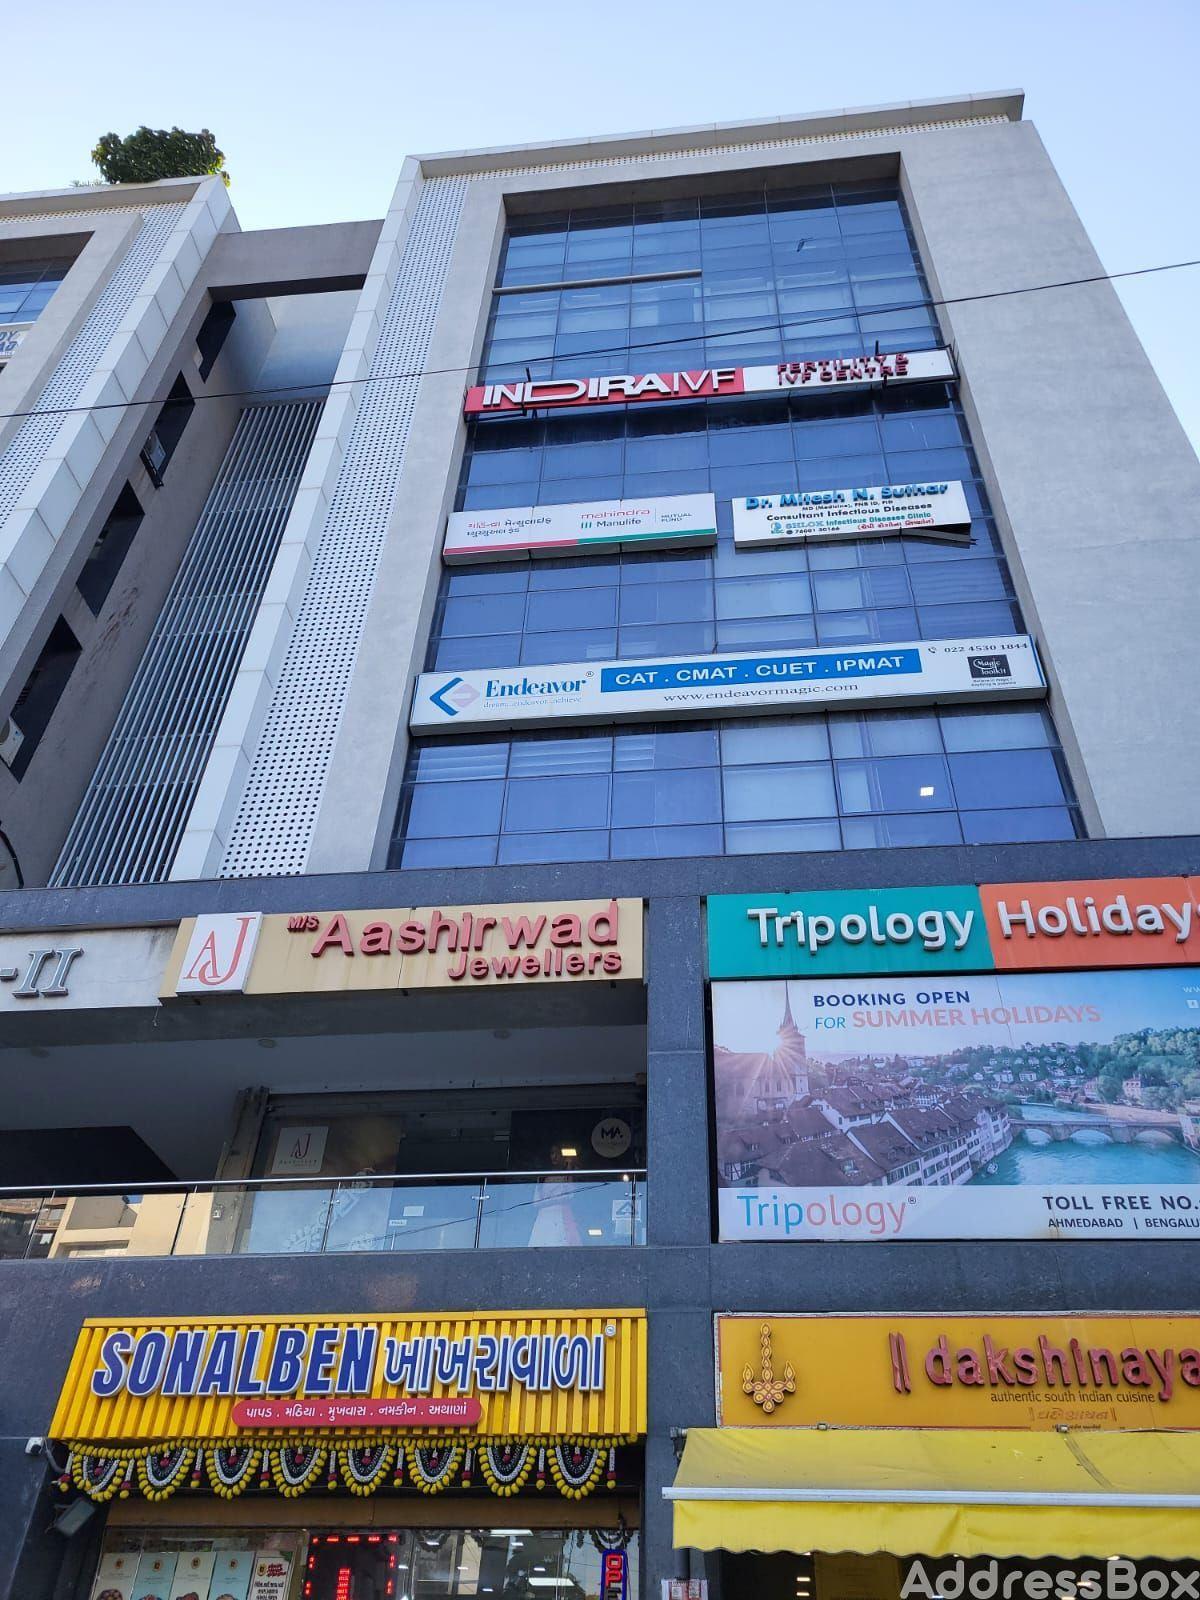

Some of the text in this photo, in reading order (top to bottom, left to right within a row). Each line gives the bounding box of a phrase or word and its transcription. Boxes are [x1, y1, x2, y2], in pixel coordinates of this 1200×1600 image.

[777, 353, 909, 375] FERTILITY &
[778, 364, 909, 386] IVF CENTRE
[745, 496, 773, 511] Dr.
[766, 502, 932, 521] Consultant Infectious Diseases
[581, 508, 650, 520] mahindra
[596, 517, 642, 528] Manulife
[968, 644, 997, 652] 4530
[1001, 642, 1028, 650] 1844
[615, 655, 905, 686] CAT CMAT CUET IPMAT
[485, 677, 588, 698] Endeavor
[663, 682, 859, 702] www.endeavormagic.com
[310, 900, 619, 957] Aashirwad
[747, 904, 975, 955] Tripology
[996, 895, 1200, 944] Holiday
[447, 949, 623, 981] Jewellers
[813, 990, 971, 1008] BOOKING OPEN
[815, 1002, 1102, 1029] FOR SUMMER HOLIDAYS
[1042, 1195, 1094, 1210] TOLL
[1101, 1195, 1152, 1210] FREE
[736, 1194, 906, 1234] Tripology
[1048, 1217, 1123, 1228] AHMEDABAD
[91, 1326, 605, 1396] SONALBEN ખાખરાવાળા
[990, 1390, 1155, 1402] authentic south indian cuisine
[246, 1406, 272, 1417] પાપડ
[285, 1403, 315, 1417] મઠિયા
[328, 1405, 366, 1421] મુખવાસ
[378, 1401, 417, 1416] નમકીન
